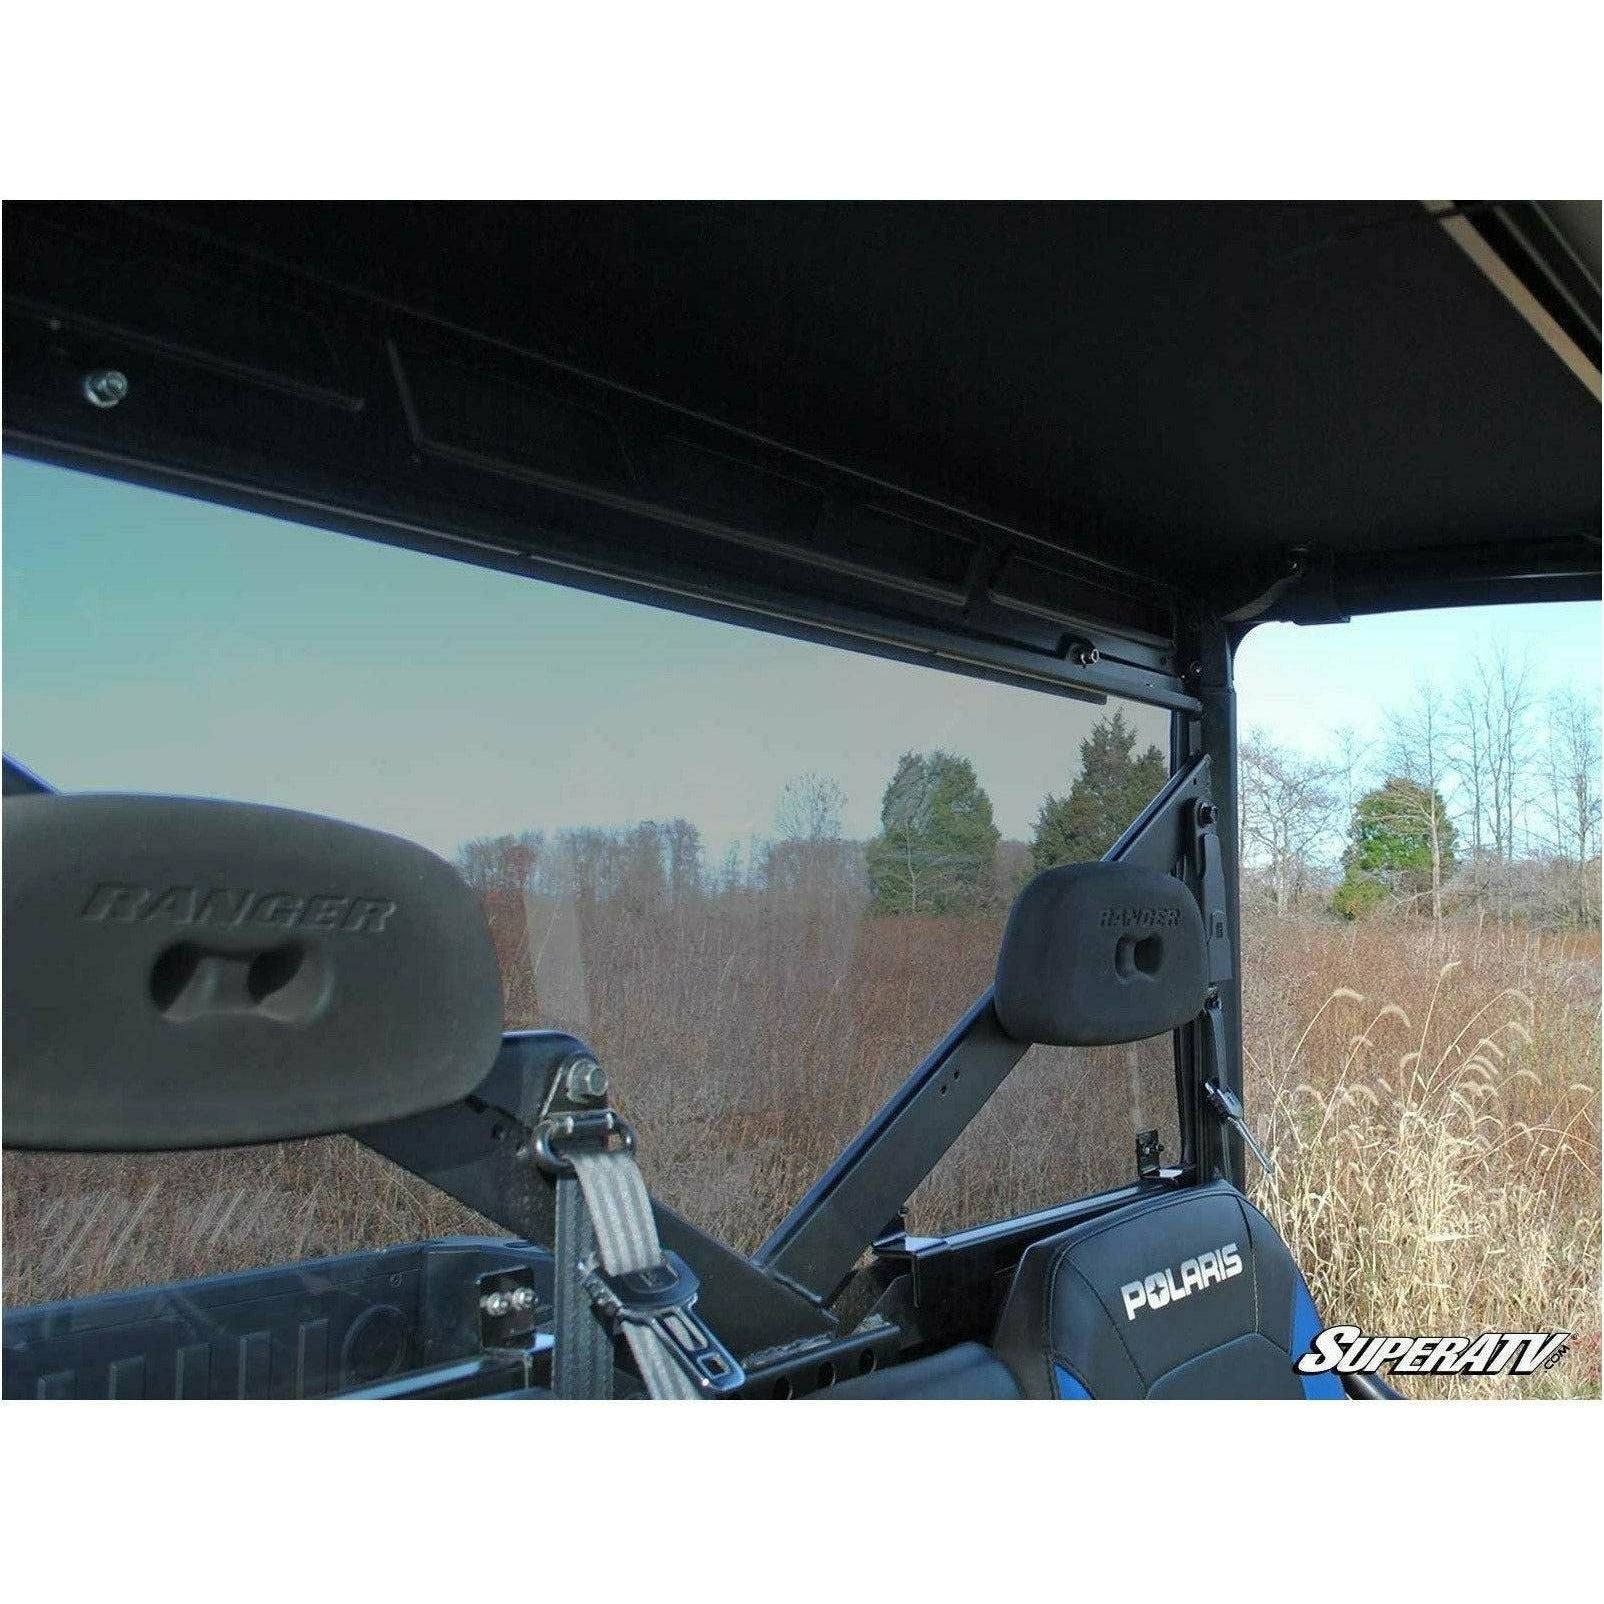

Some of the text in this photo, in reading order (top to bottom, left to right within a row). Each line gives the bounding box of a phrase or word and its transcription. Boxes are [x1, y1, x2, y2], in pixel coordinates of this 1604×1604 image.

[81, 882, 396, 934] RANGER
[1099, 906, 1181, 927] RANGER
[1121, 1243, 1243, 1320] POLARIS
